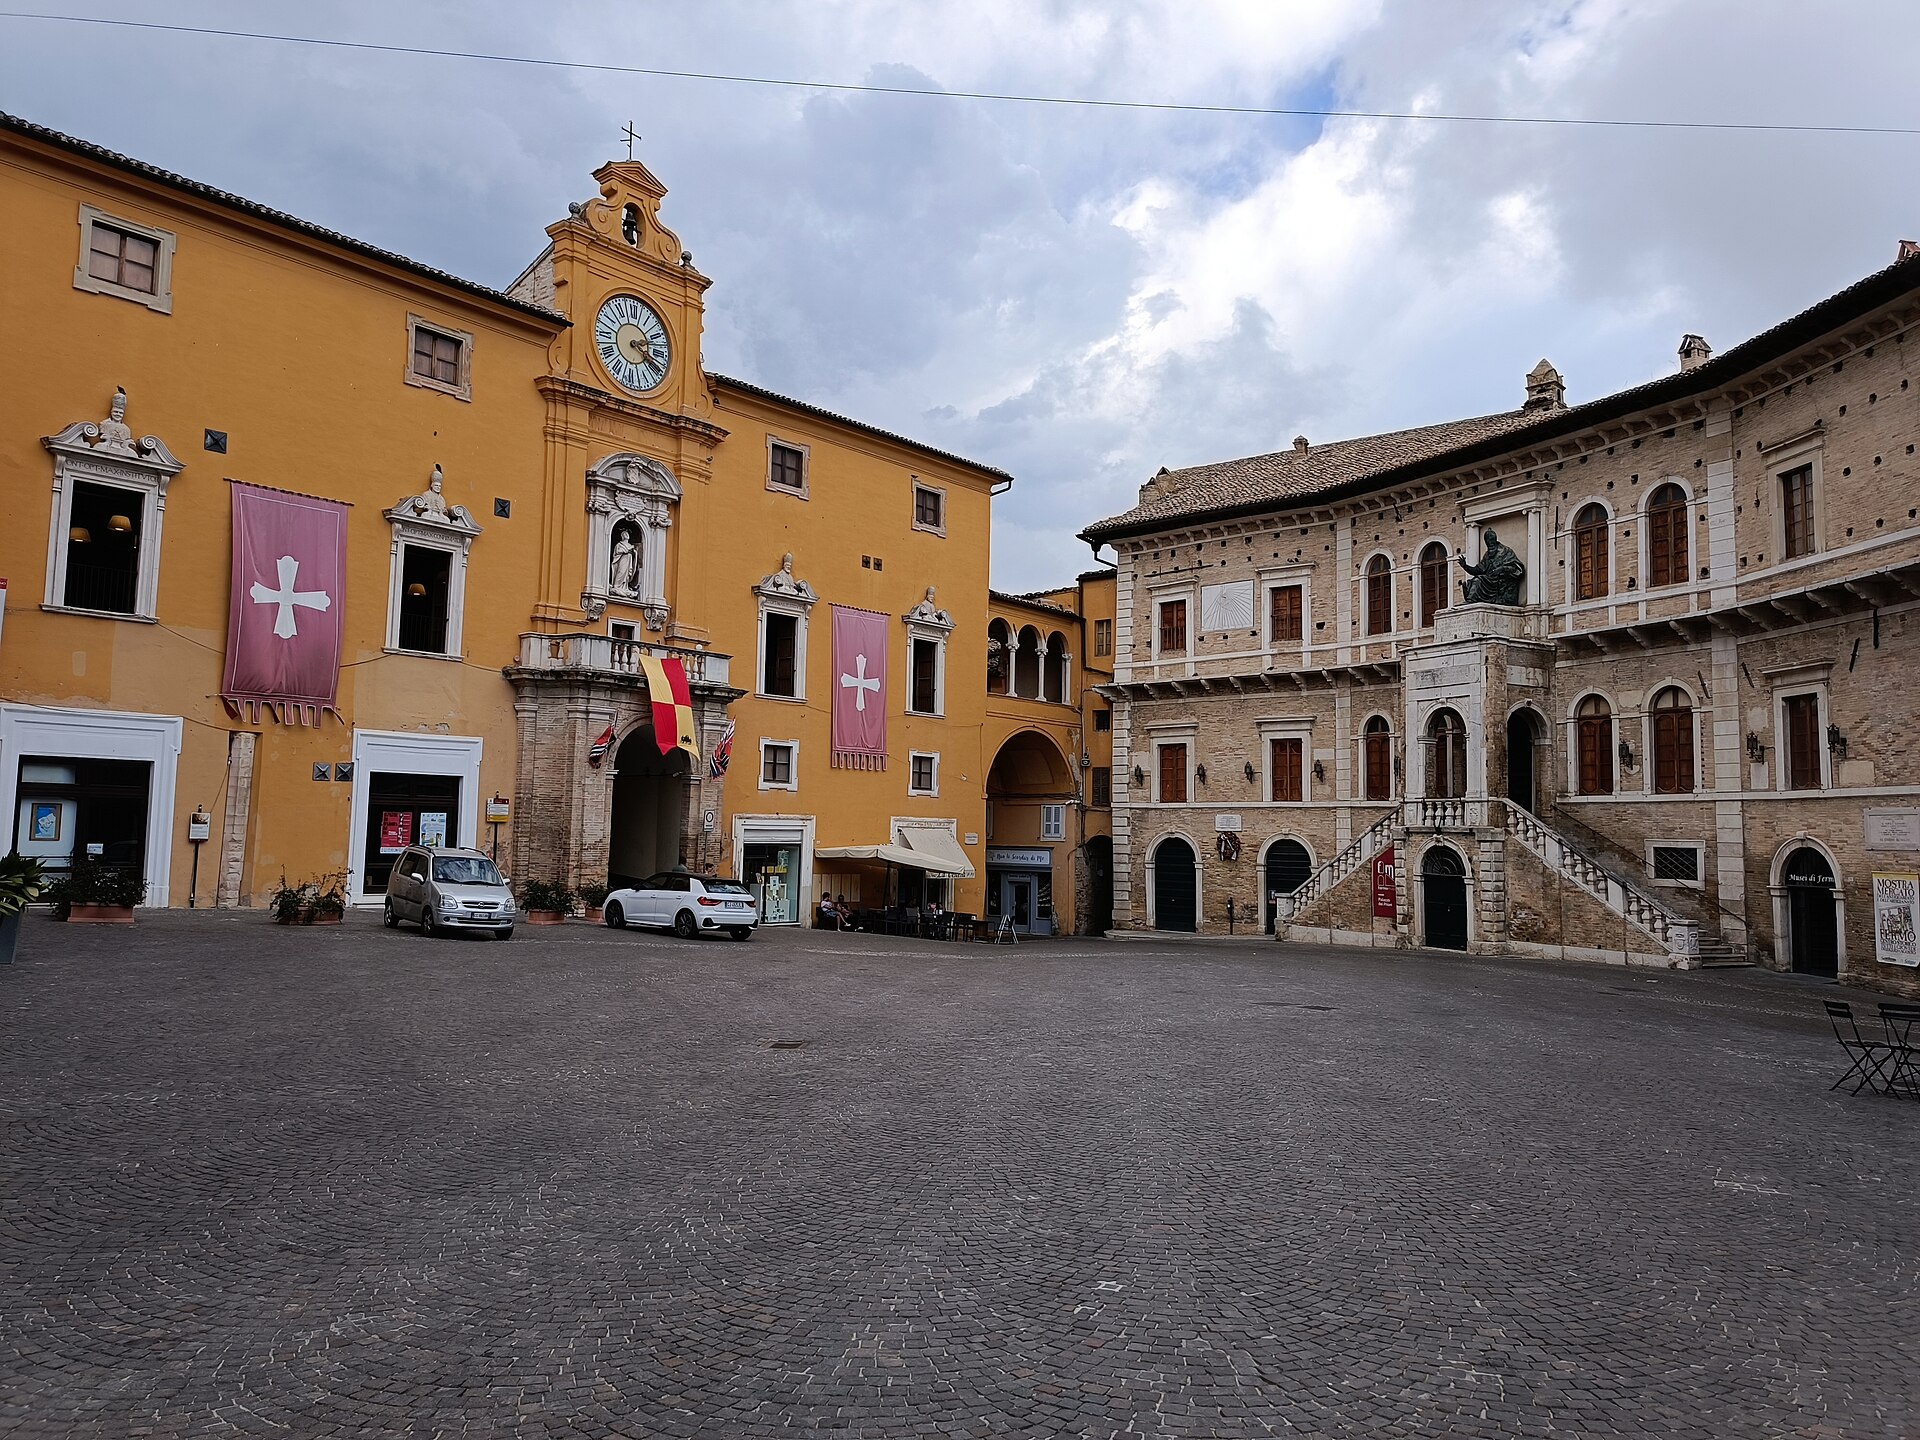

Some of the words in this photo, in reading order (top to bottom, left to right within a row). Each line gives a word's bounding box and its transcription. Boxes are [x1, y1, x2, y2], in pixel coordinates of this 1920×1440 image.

[1788, 874, 1808, 882] Musei
[1808, 873, 1816, 882] di
[1816, 874, 1835, 884] Ferm
[1877, 878, 1914, 889] MOSTRA
[1877, 886, 1915, 897] MERCATO
[1880, 928, 1916, 942] FERMO
